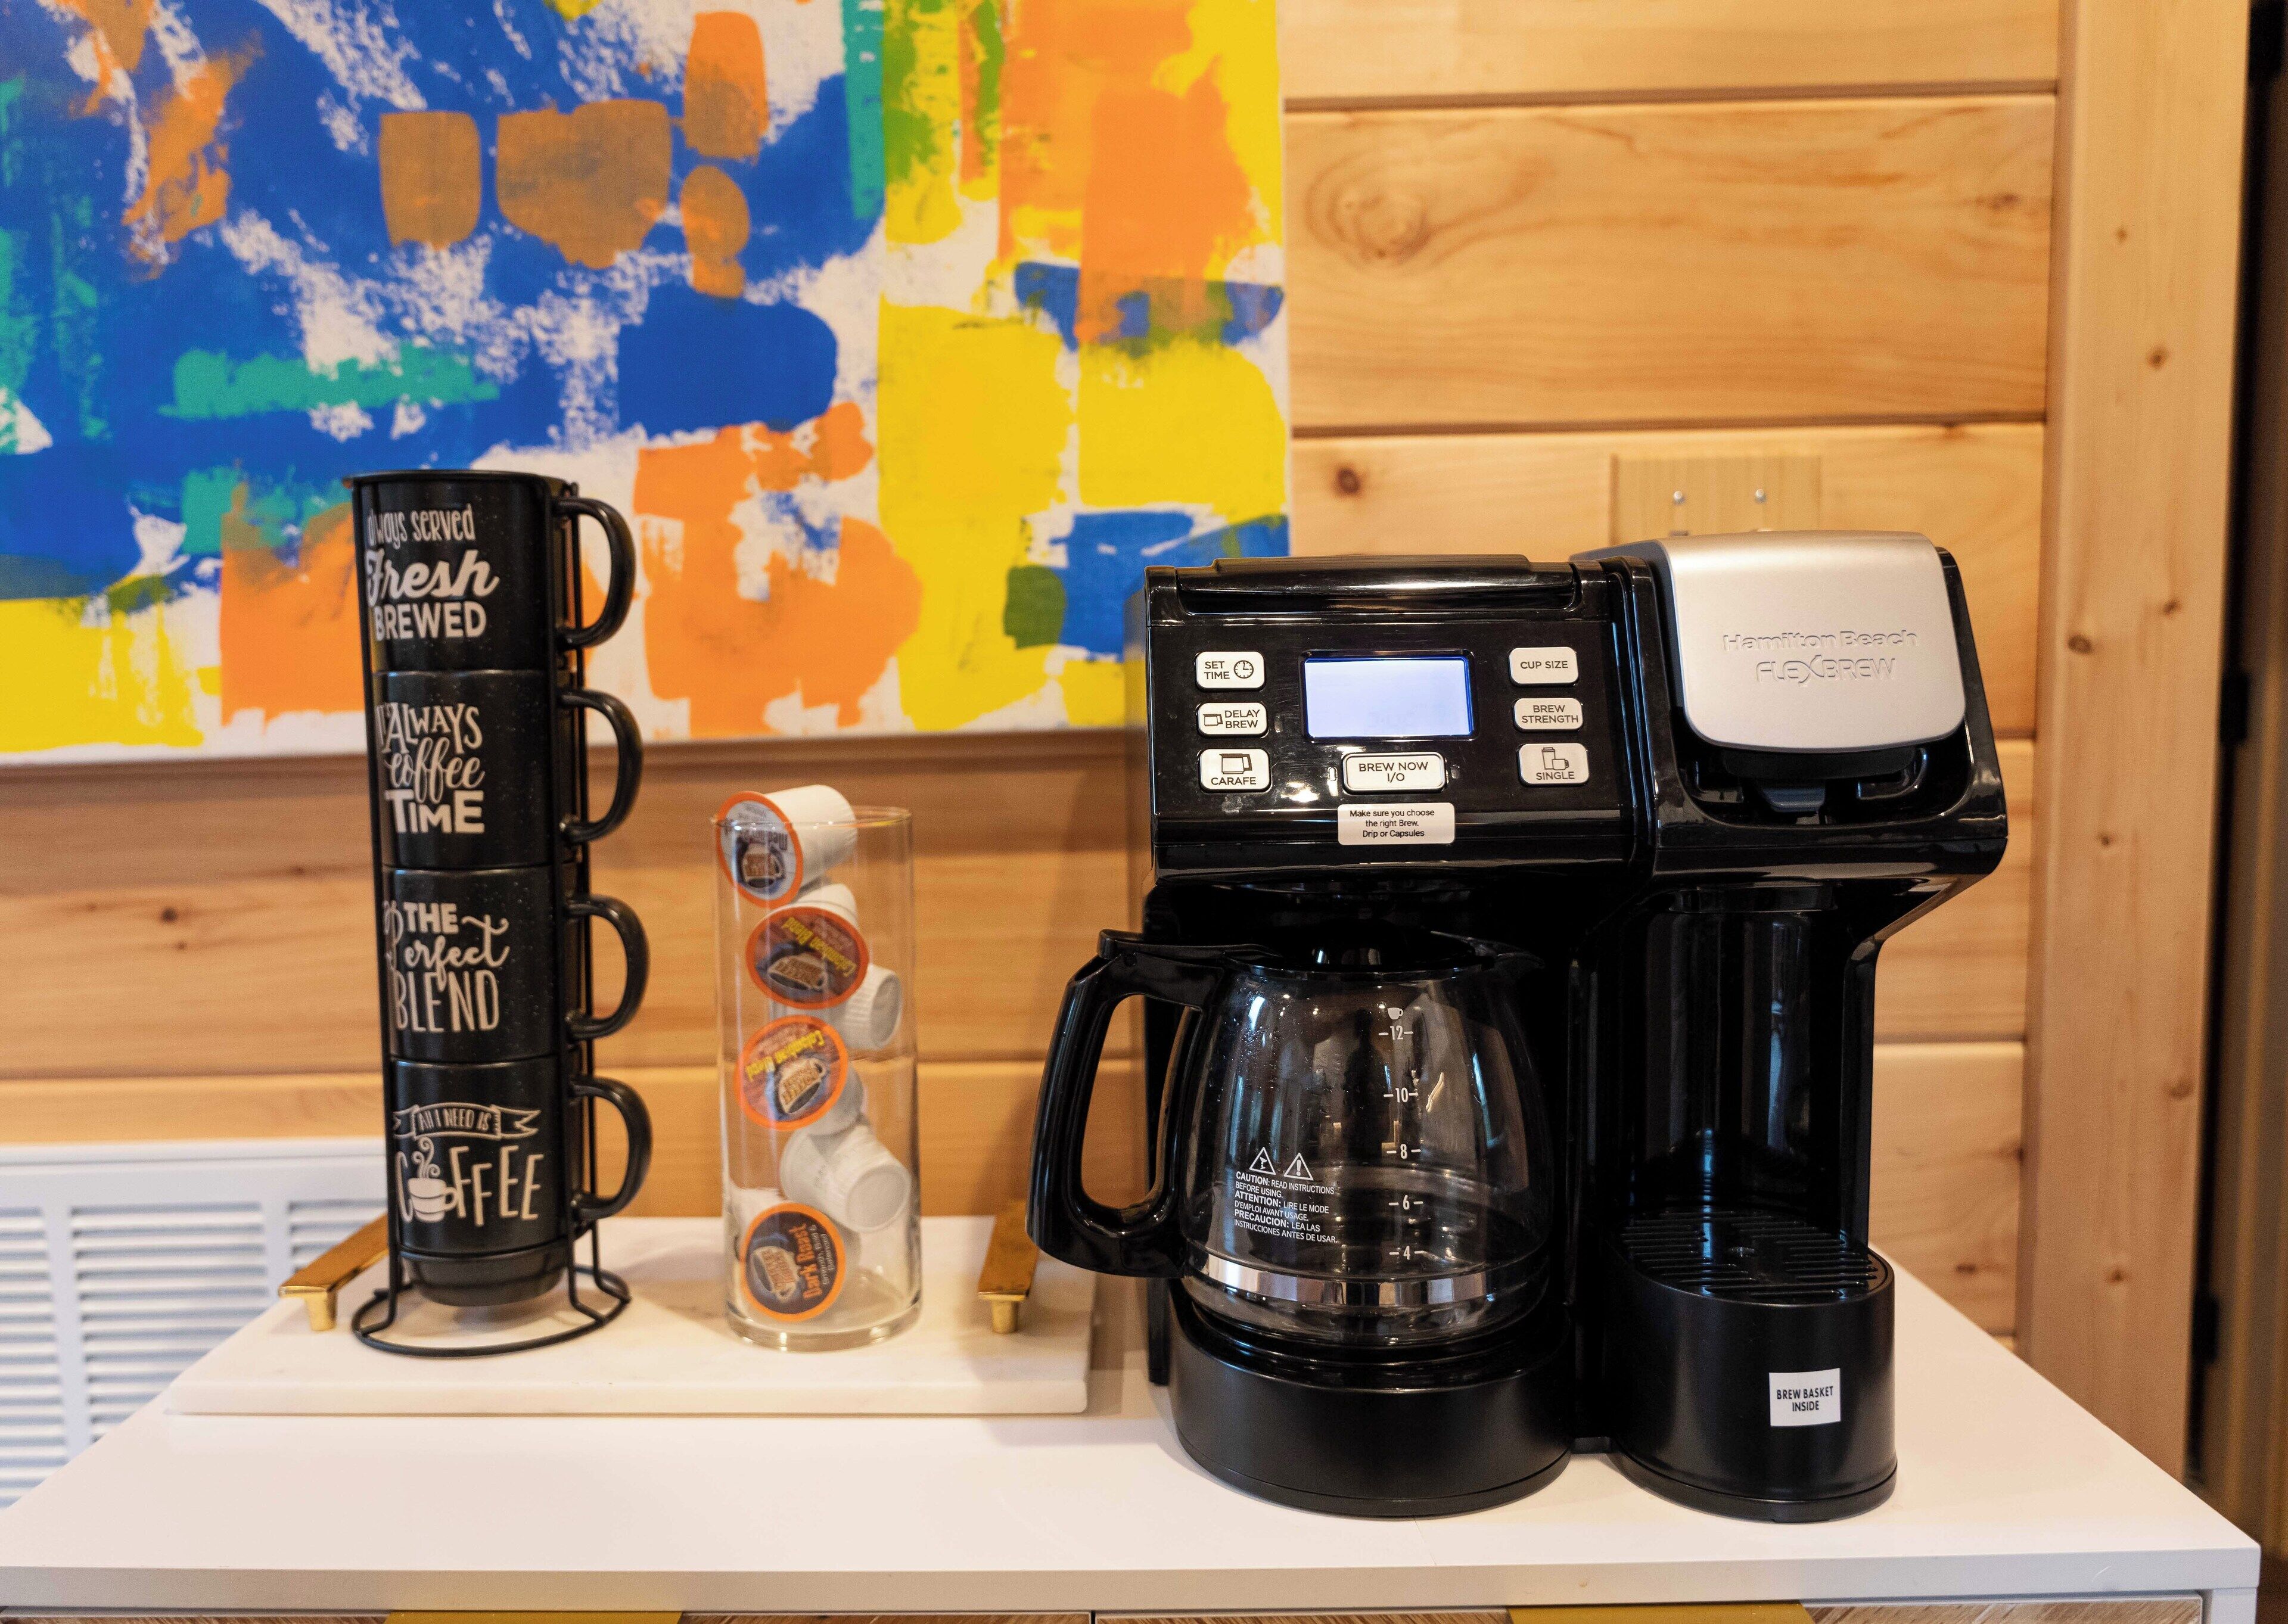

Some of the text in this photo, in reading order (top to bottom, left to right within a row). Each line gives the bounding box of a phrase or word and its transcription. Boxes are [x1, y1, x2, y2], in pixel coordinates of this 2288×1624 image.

[365, 547, 500, 607] Fresh
[374, 601, 487, 642] BREWED
[1723, 630, 1919, 651] Hamilton Beach
[1204, 661, 1225, 670] SET
[1519, 660, 1569, 670] CUP SIZE
[1204, 671, 1230, 680] TIME
[1224, 709, 1261, 718] DELAY
[1532, 704, 1566, 713] BREW
[1225, 720, 1258, 729] BREW
[1521, 714, 1580, 724] STRENGTH
[1358, 761, 1429, 772] BREW NOW
[1210, 776, 1257, 786] CARAFE
[1535, 771, 1575, 780] SINGLE
[1379, 819, 1398, 829] right
[1398, 819, 1419, 827] Brew.
[1362, 829, 1379, 838] Drip
[1389, 829, 1425, 838] Capsules
[402, 901, 459, 935] THE
[393, 968, 500, 1034] BLEND
[1389, 1025, 1404, 1040] 12
[1395, 1087, 1409, 1103] 10
[443, 1108, 475, 1130] NEED
[477, 1111, 492, 1132] IS
[1400, 1144, 1408, 1159] 8
[1235, 1182, 1283, 1199] BEFORE USING.
[1236, 1171, 1335, 1195] CAUTION: READ INSTRUCTIONS
[1235, 1190, 1281, 1208] ATTENTION:
[1283, 1202, 1298, 1211] LIRE
[1308, 1205, 1329, 1214] MODE
[1403, 1194, 1410, 1210] 6
[1235, 1200, 1309, 1222] D'EMPLOI AVANT USAGE.
[1234, 1209, 1289, 1228] PRECAUCION:
[1306, 1223, 1320, 1233] LAS
[1234, 1219, 1280, 1236] INSTRUCCIONES
[1281, 1230, 1304, 1240] ANTES
[1403, 1245, 1410, 1261] 4
[1776, 1386, 1833, 1399] BREW BASKET
[1792, 1401, 1819, 1412] INSIDE
